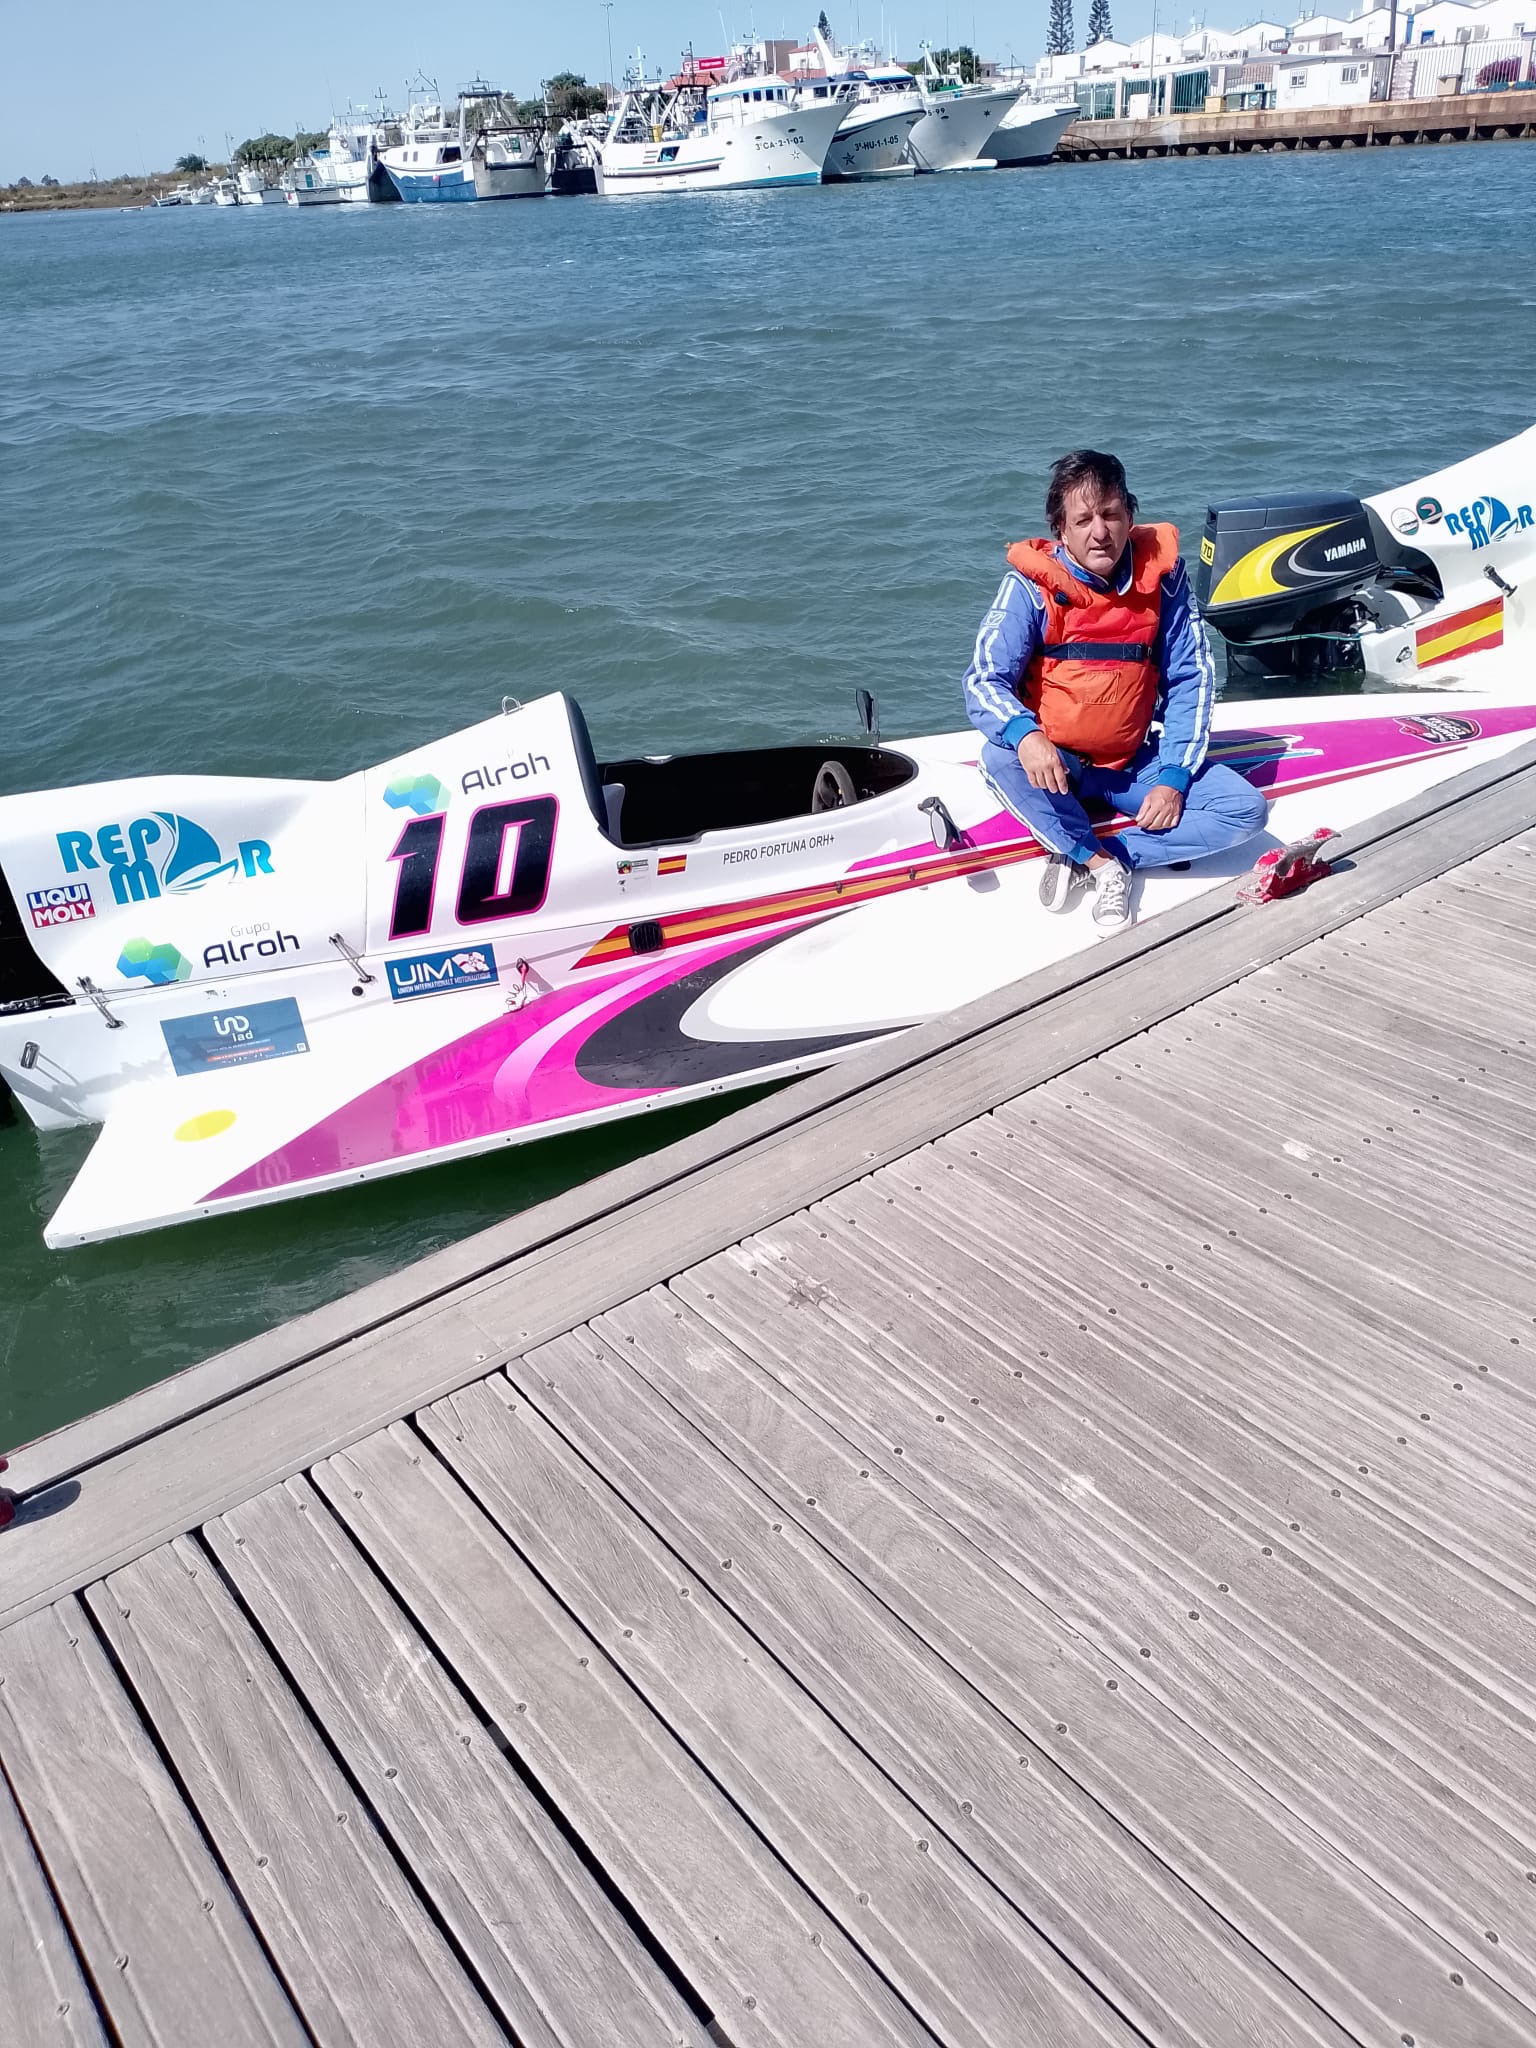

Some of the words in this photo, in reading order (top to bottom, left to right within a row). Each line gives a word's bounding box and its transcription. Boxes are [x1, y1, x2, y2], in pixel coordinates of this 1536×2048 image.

[1324, 537, 1367, 562] YAMAHA
[461, 752, 551, 795] Alroh
[723, 848, 758, 865] PEDRO
[760, 839, 807, 859] FORTUNA
[809, 833, 835, 849] ORH+
[386, 792, 561, 942] 10
[27, 884, 89, 910] LIQUI
[34, 901, 94, 927] MOLY
[230, 921, 271, 937] Grupo
[203, 930, 300, 968] Alroh
[393, 958, 455, 986] UIM
